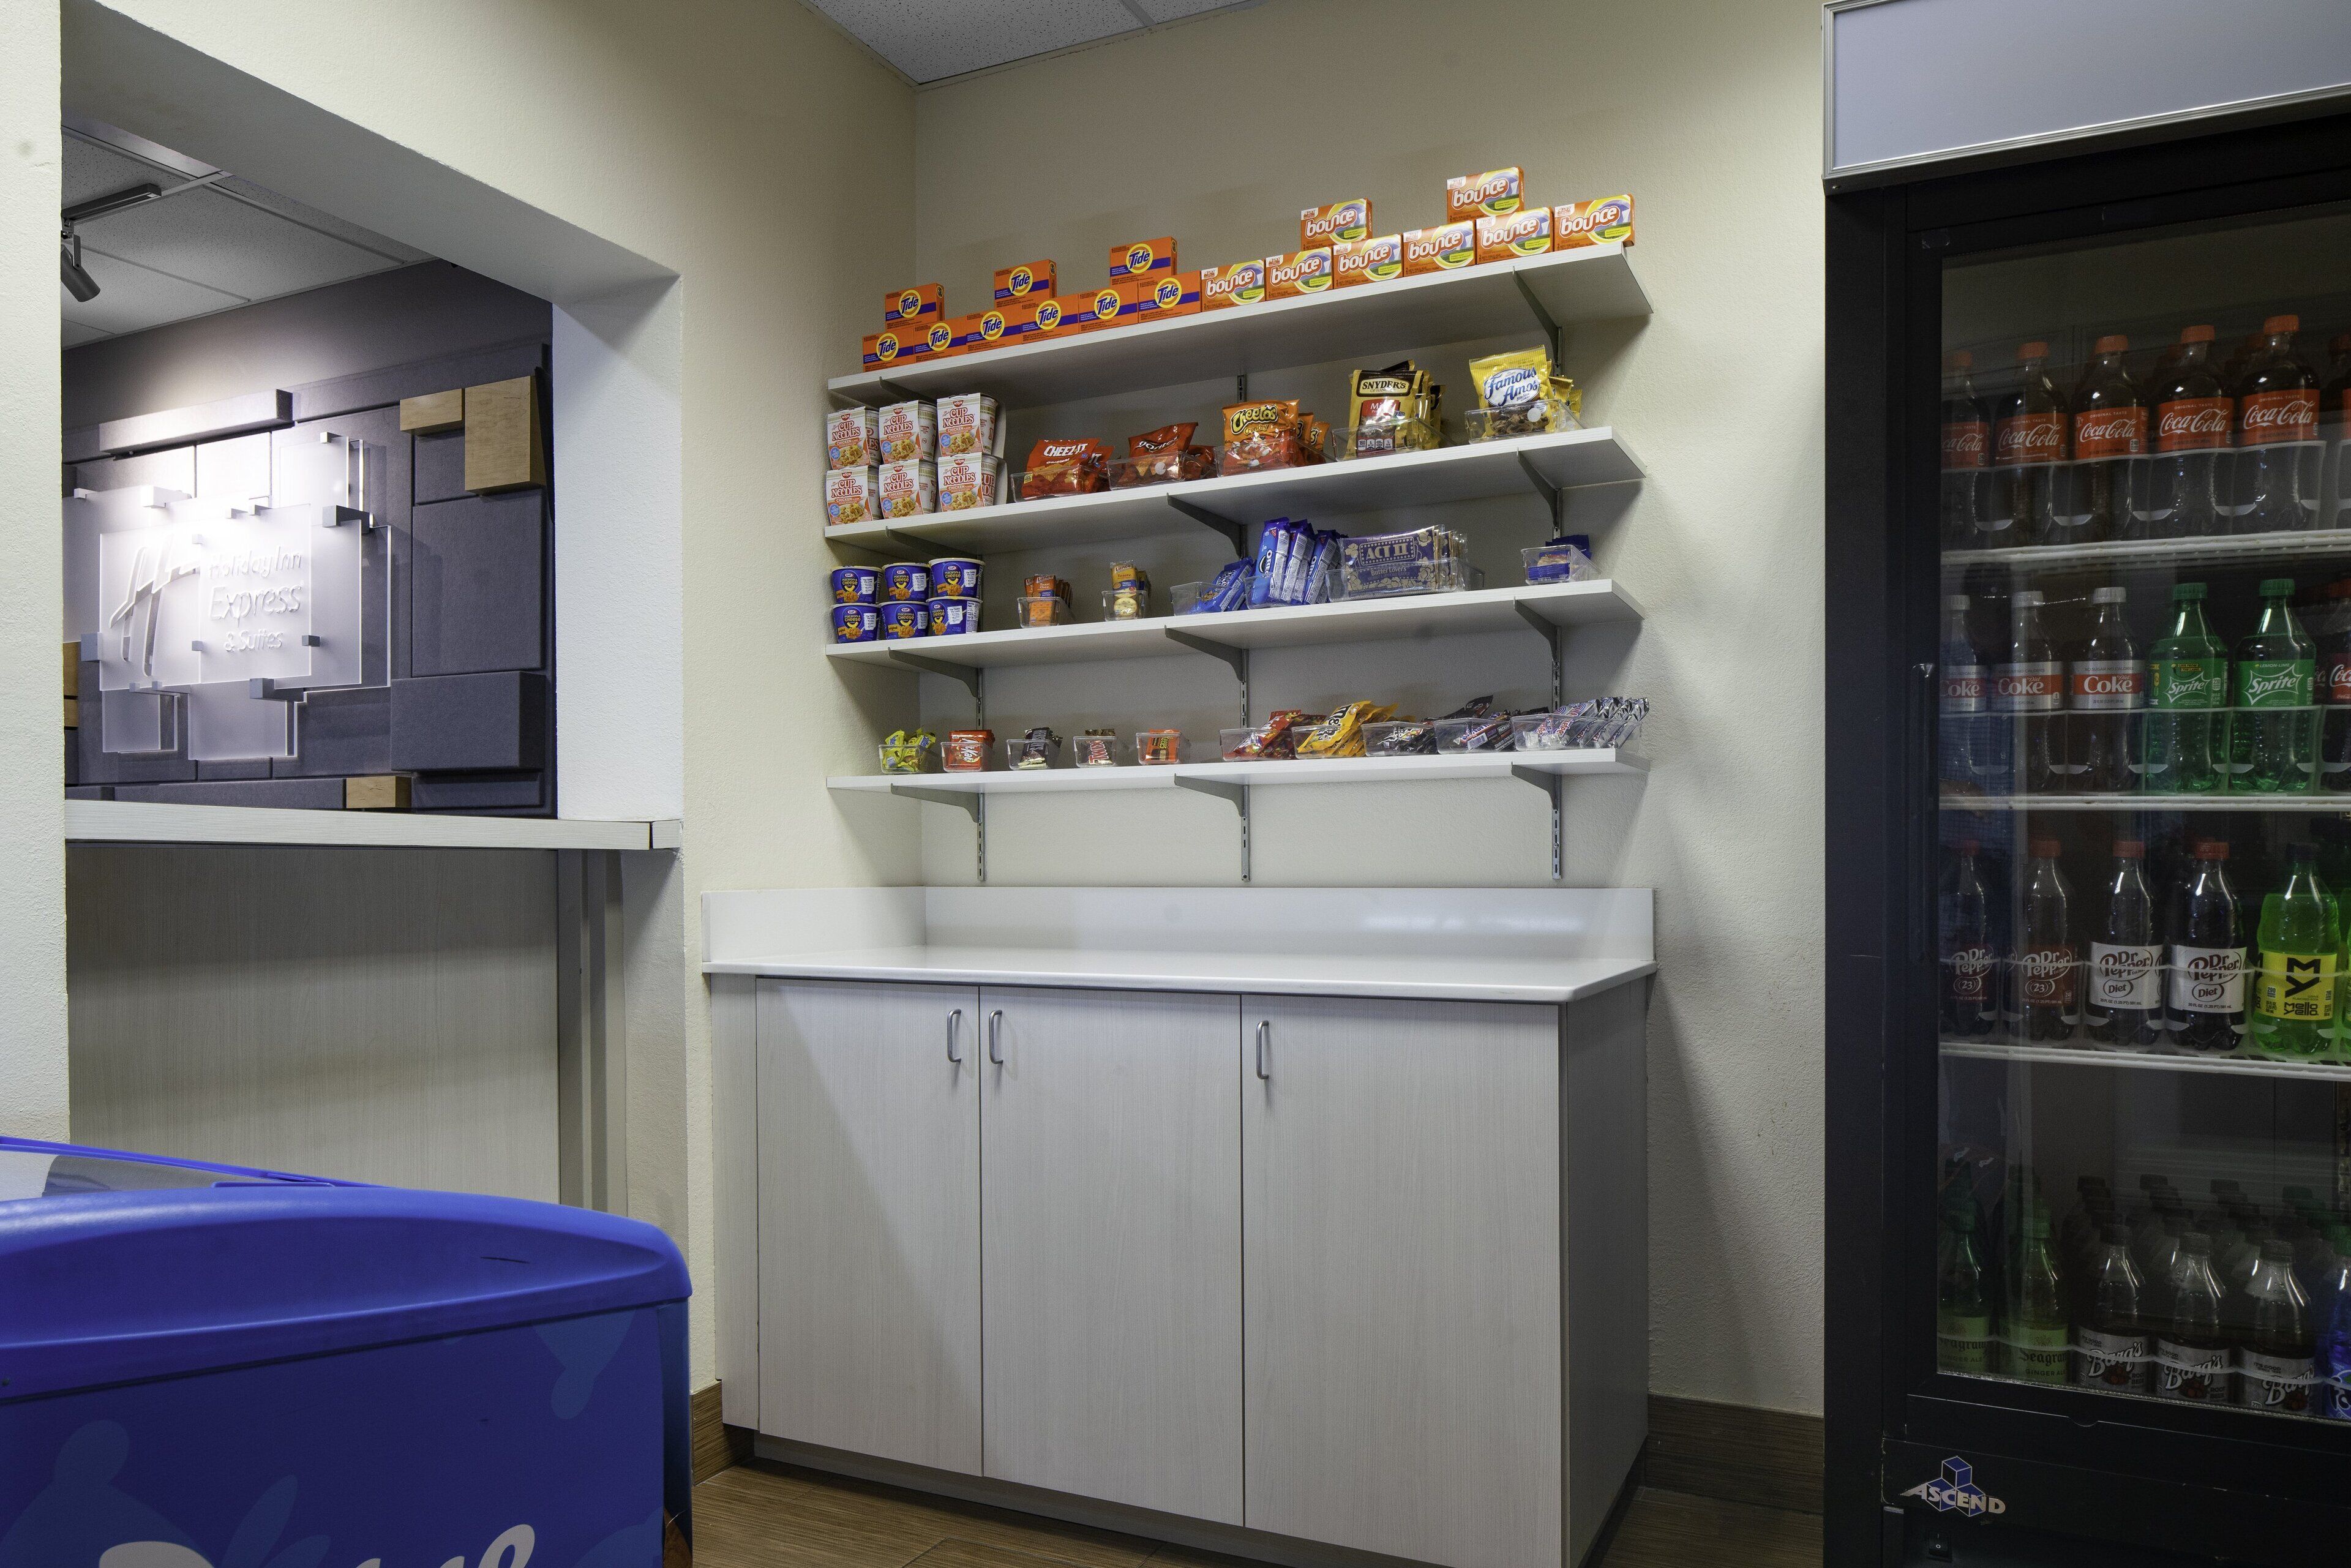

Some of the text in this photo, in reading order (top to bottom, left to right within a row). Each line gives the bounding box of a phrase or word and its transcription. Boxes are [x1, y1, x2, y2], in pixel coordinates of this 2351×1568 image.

[1453, 179, 1505, 207] bounce
[1307, 210, 1355, 236] bounce
[1561, 208, 1617, 235] bounce
[1482, 219, 1538, 247] bounce
[1409, 232, 1462, 260] bounce
[1128, 252, 1150, 269] Tide
[1340, 246, 1389, 272] bounce
[1272, 259, 1319, 283] bounce
[1011, 274, 1030, 291] Tide
[1206, 271, 1253, 295] bounce
[1157, 286, 1179, 303] Tide
[901, 297, 919, 313] Tide
[1097, 298, 1117, 315] Tide
[1038, 307, 1059, 324] Tide
[983, 318, 1002, 336] Tide
[931, 329, 948, 346] Tide
[879, 340, 896, 356] Tide
[1362, 380, 1406, 390] SNYDER'S
[1484, 367, 1537, 400] Famous
[890, 415, 907, 425] CUP
[943, 414, 974, 427] NOODLES
[950, 407, 967, 418] CUP
[1231, 405, 1277, 433] Cheetos
[2243, 400, 2315, 430] Coca-Cola
[838, 421, 854, 431] CUP
[884, 421, 913, 435] NOODLES
[2080, 419, 2137, 442] Coca-Cola
[2160, 408, 2229, 437] Coca-Cola
[832, 427, 861, 441] NOODLES
[1998, 424, 2061, 451] Coca-Cola
[890, 473, 907, 482] CUP
[951, 465, 969, 476] CUP
[838, 479, 855, 488] CUP
[884, 479, 913, 492] NOODLES
[943, 473, 976, 486] NOODLES
[831, 486, 862, 498] NOODLES
[1366, 542, 1408, 560] ACT II
[209, 546, 302, 578] Holiday Inn
[210, 585, 302, 627] Express
[225, 629, 283, 652] & Suites
[1998, 677, 2044, 695] Coke
[2083, 676, 2133, 693] Coke
[2170, 678, 2205, 696] Sprite
[2248, 673, 2297, 694] Sprite
[1968, 948, 1985, 961] Dr
[2039, 951, 2058, 963] Dr
[2122, 950, 2140, 963] Dr
[2210, 955, 2229, 967] Dr
[1961, 978, 1973, 989] 23
[2033, 983, 2045, 992] 23
[2108, 983, 2127, 994] Diet
[2199, 988, 2217, 997] Diet
[2087, 1341, 2143, 1377] Barq's
[2164, 1355, 2222, 1390] Barq's
[1900, 1484, 2006, 1514] ASCEND
